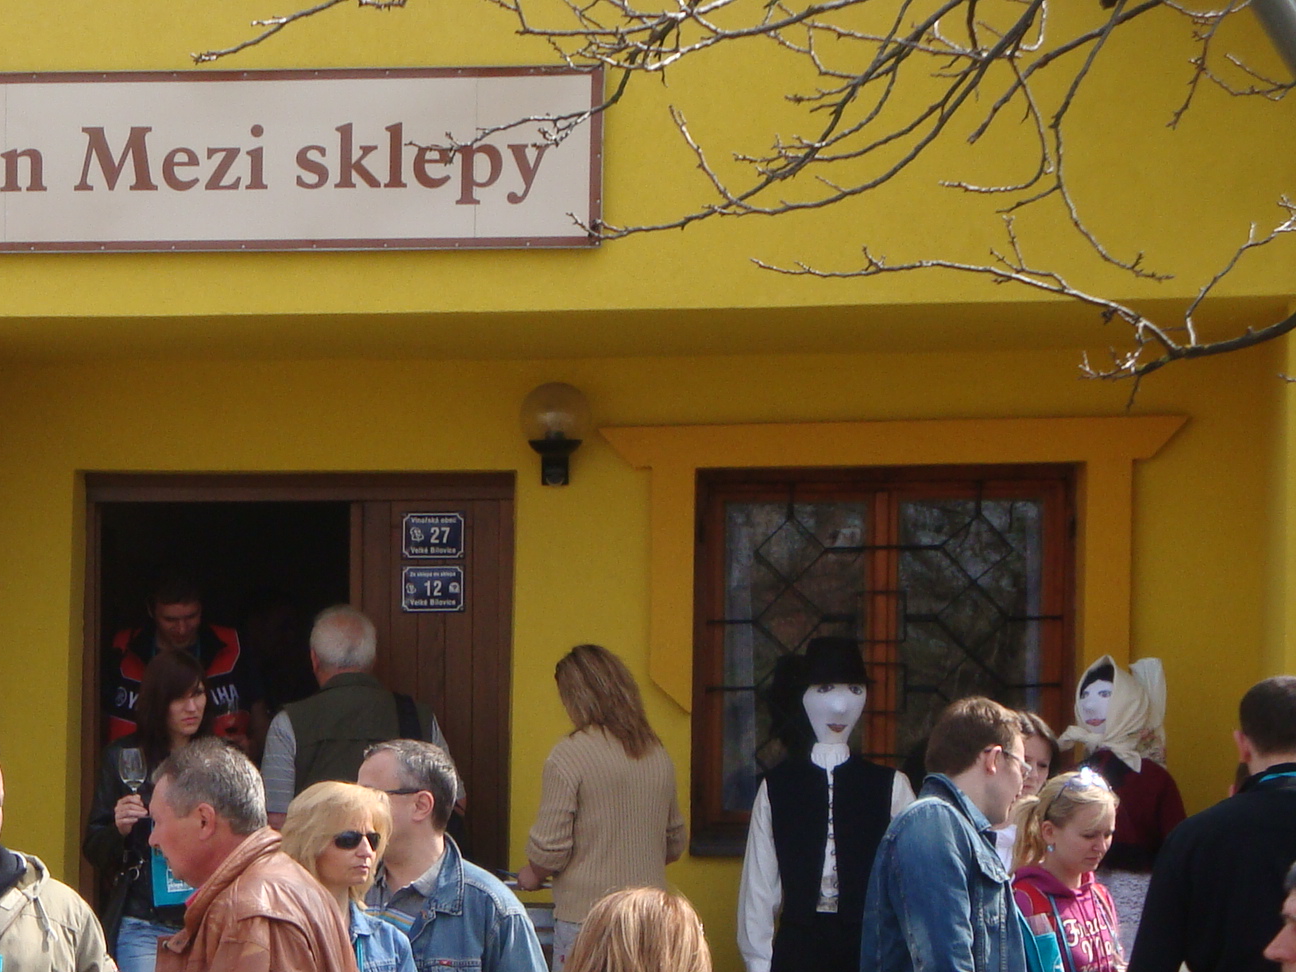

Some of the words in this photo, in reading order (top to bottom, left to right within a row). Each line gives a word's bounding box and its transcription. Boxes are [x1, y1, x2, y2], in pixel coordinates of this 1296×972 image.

[73, 123, 268, 192] Mezi
[295, 121, 552, 205] sklepy
[430, 526, 451, 544] 27
[410, 546, 429, 554] Velké
[423, 580, 443, 597] 12
[409, 598, 428, 606] Velké
